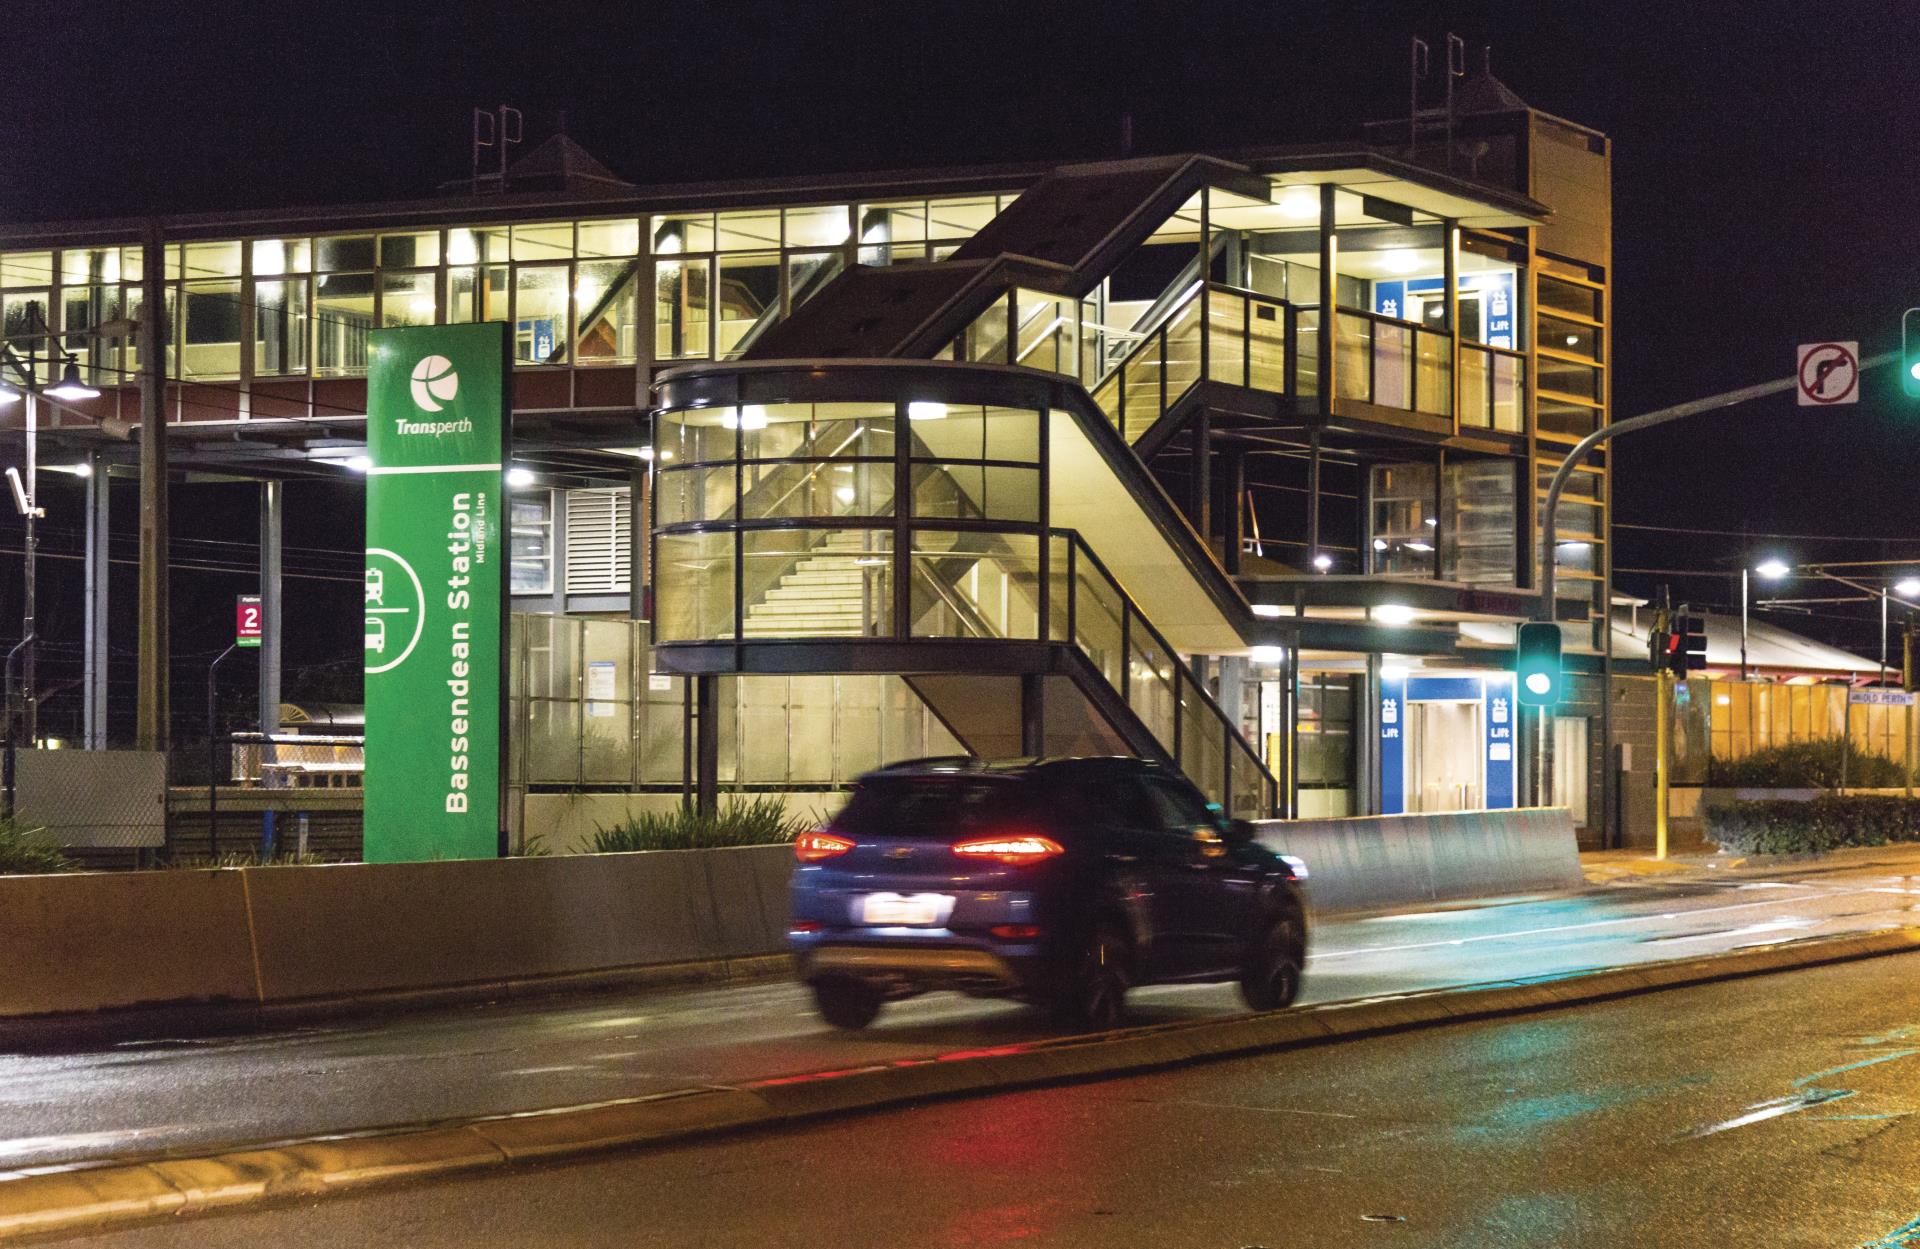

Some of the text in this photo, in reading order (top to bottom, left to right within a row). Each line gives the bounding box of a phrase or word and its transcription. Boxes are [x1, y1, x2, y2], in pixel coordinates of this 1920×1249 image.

[1490, 321, 1509, 331] Lift
[395, 416, 473, 437] Transperth
[475, 492, 486, 564] Midland Line
[245, 608, 258, 627] 2
[445, 492, 471, 814] Bassendean Station
[1863, 694, 1878, 702] OLD
[1882, 694, 1906, 704] PERTH
[1382, 728, 1399, 738] Lift
[1491, 728, 1510, 738] Lift
